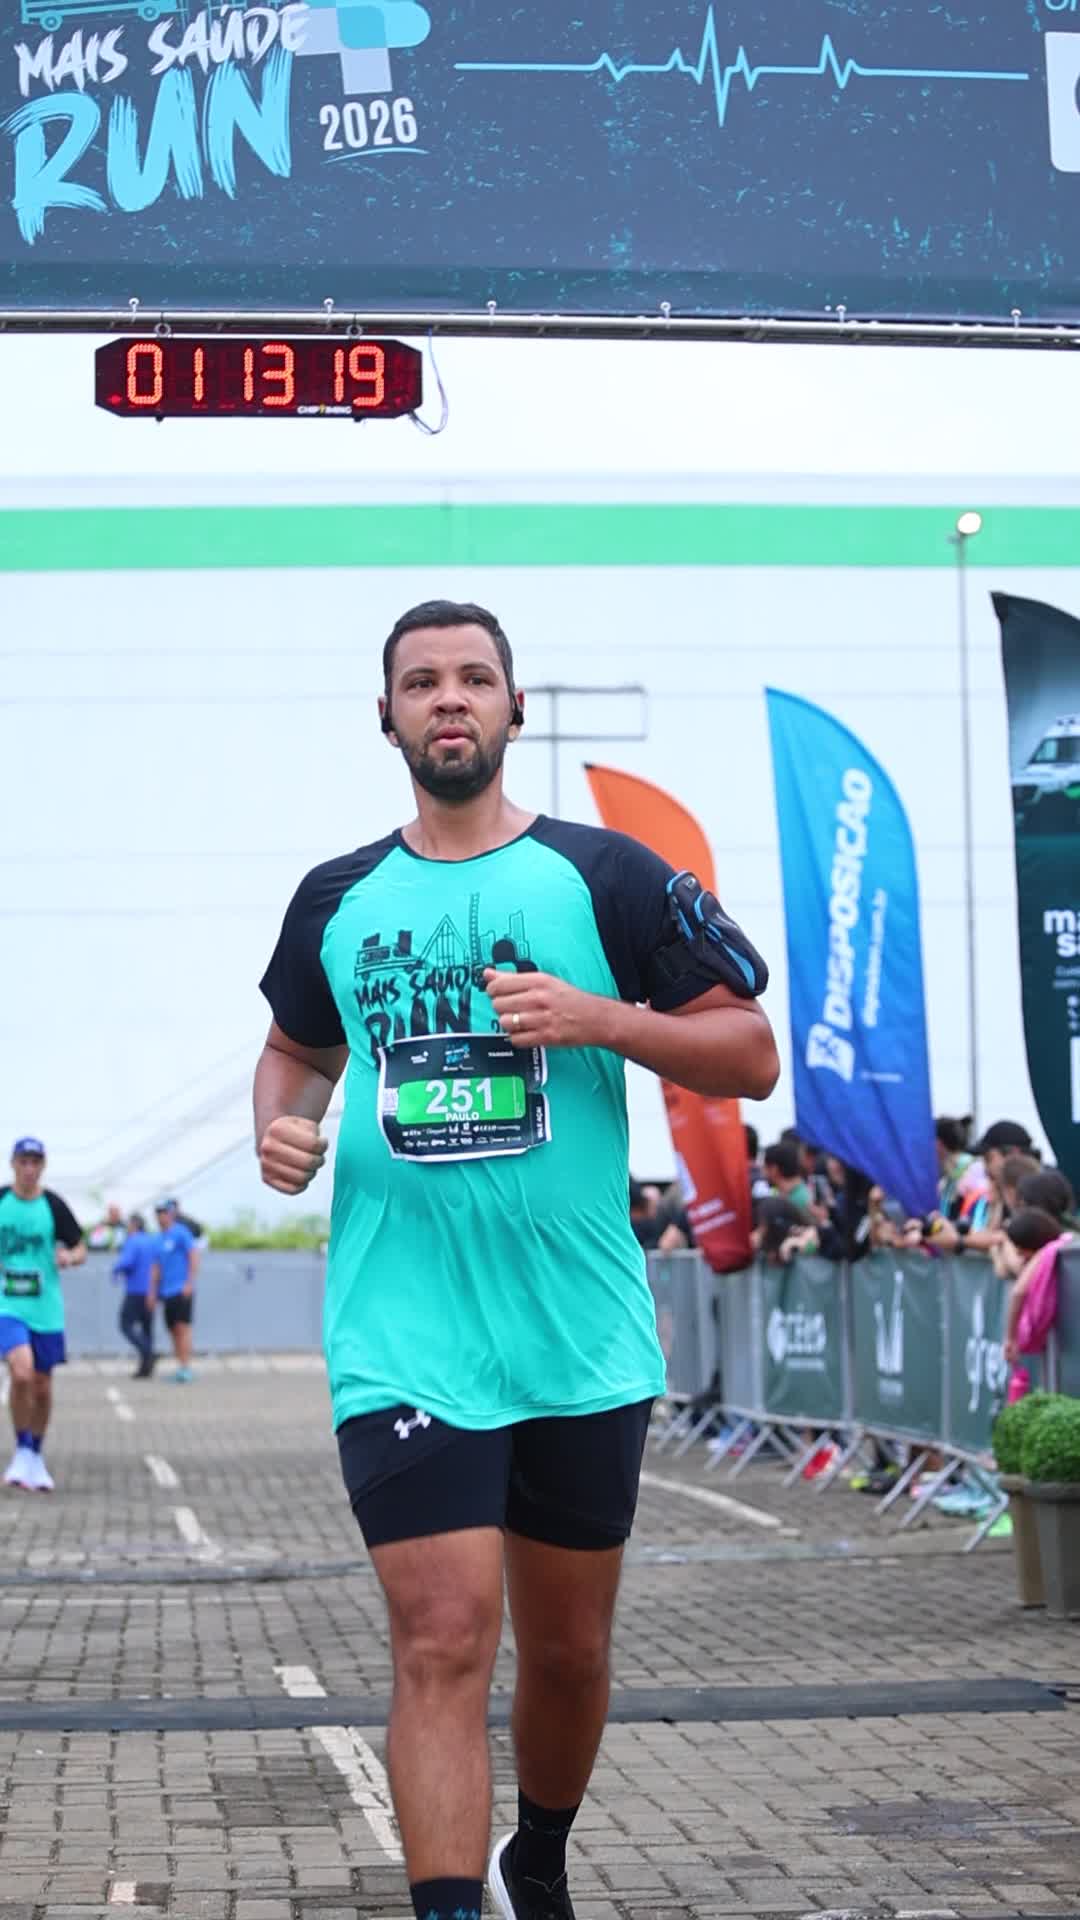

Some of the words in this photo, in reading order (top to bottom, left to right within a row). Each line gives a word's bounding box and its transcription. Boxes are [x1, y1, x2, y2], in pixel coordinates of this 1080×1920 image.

[14, 24, 128, 97] MAIS
[148, 4, 311, 76] SAÚDE
[0, 47, 294, 246] RUN
[319, 97, 418, 151] 2026
[243, 344, 295, 406] 13
[333, 345, 385, 407] 19
[354, 974, 401, 1016] MAIS
[425, 1077, 493, 1114] 251
[445, 1111, 480, 1122] PAULO
